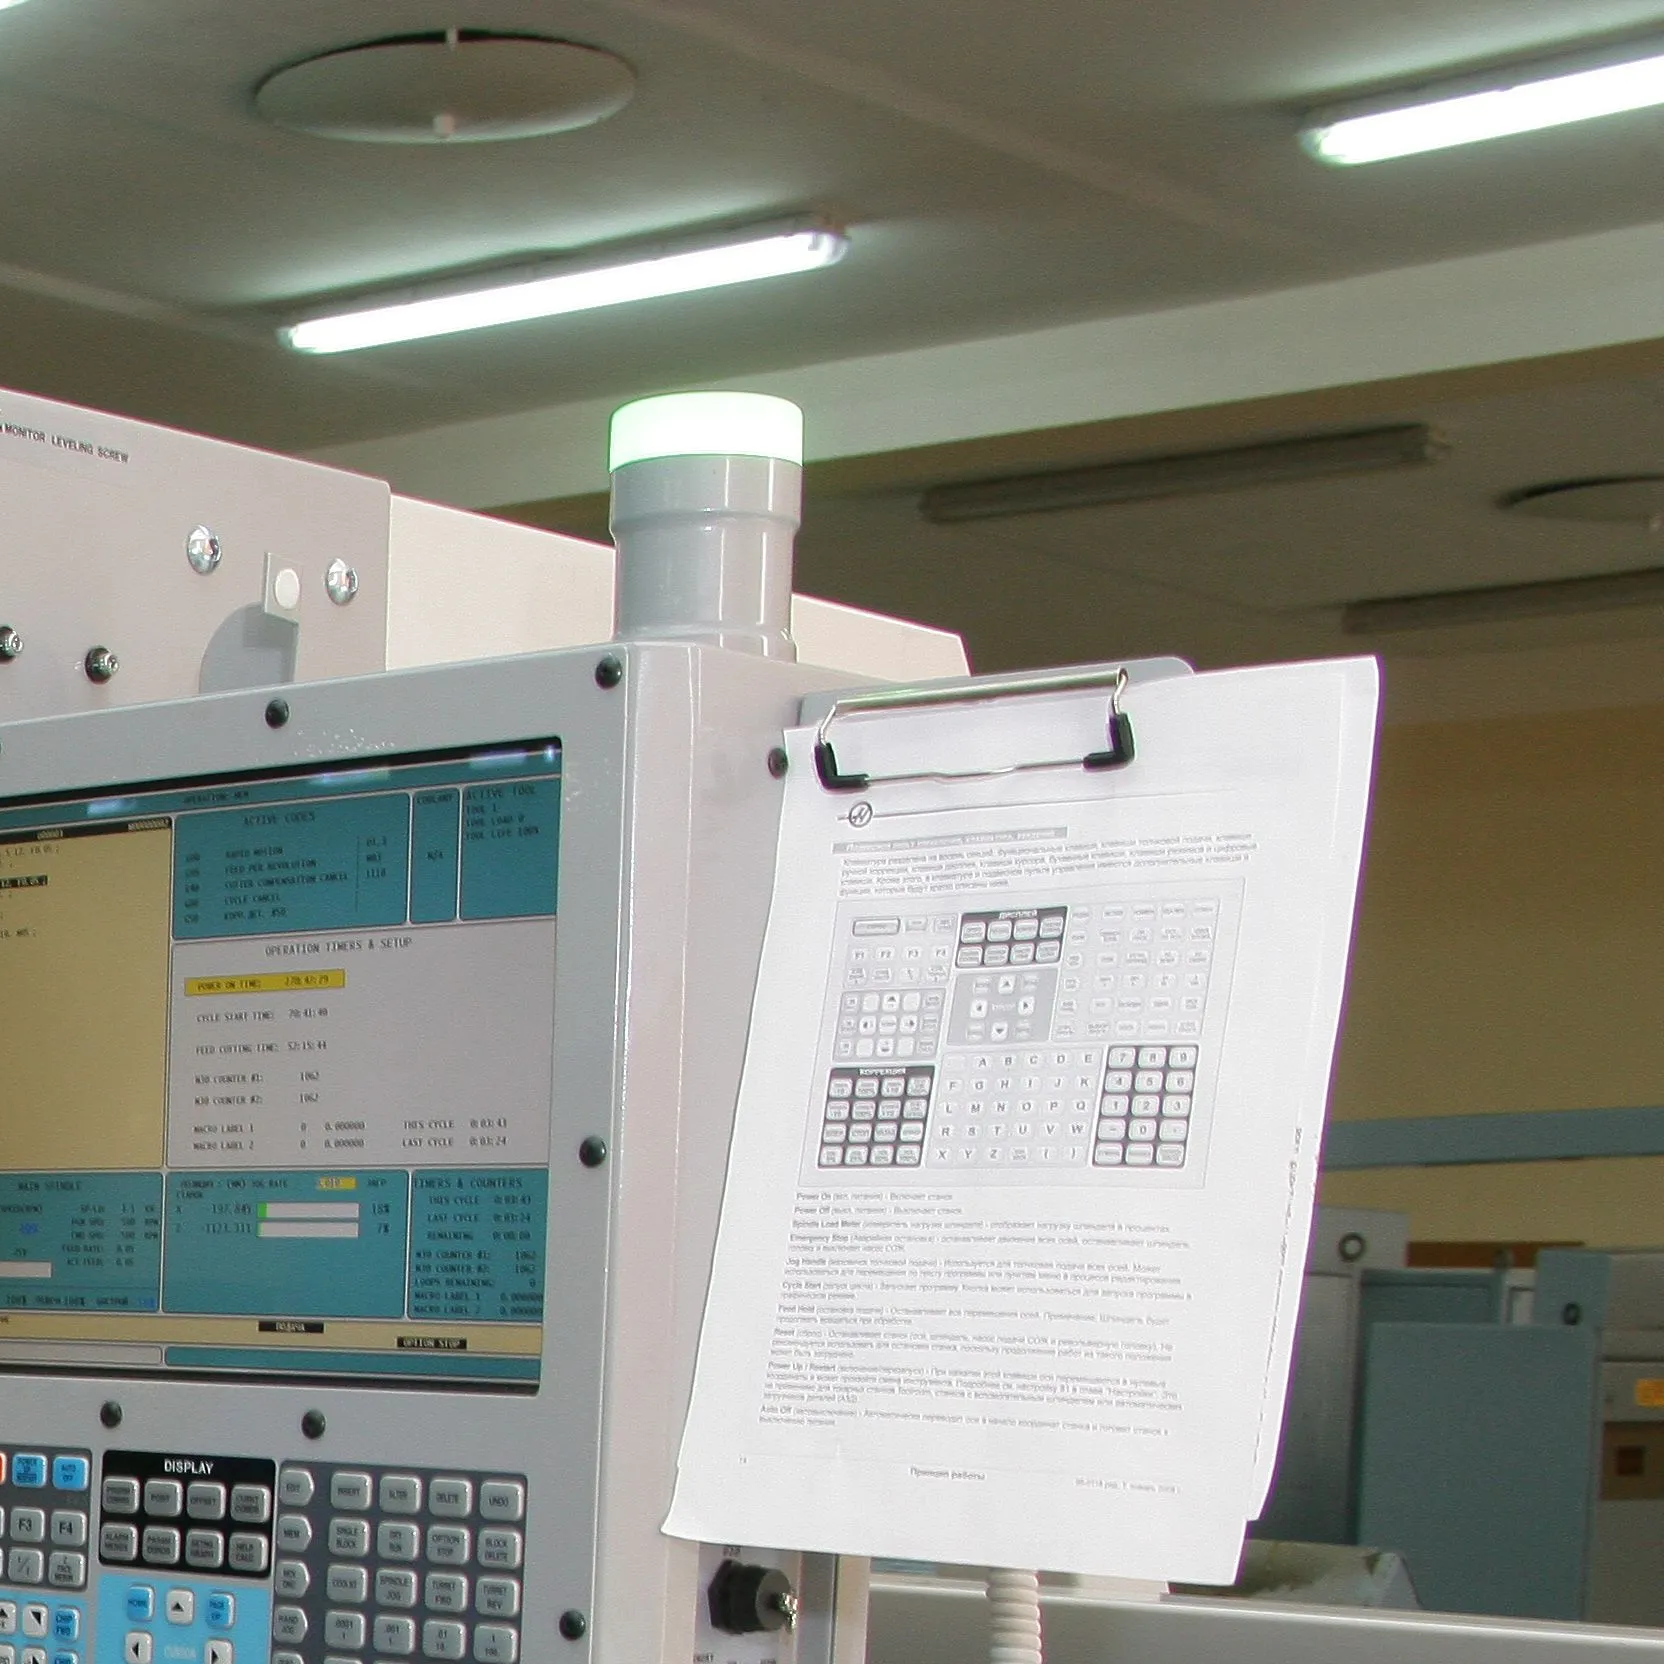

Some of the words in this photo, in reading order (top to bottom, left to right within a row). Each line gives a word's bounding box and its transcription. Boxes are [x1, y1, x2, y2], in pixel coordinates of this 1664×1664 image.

[4, 423, 45, 442] MONITOR
[52, 435, 93, 455] LEVELING
[98, 446, 128, 463] SCREW
[265, 944, 320, 957] OPERATION
[326, 941, 362, 953] TIMERS
[381, 938, 412, 949] SETUP
[164, 1459, 214, 1474] DISPLAY
[19, 1518, 32, 1531] F3
[59, 1522, 72, 1534] F4
